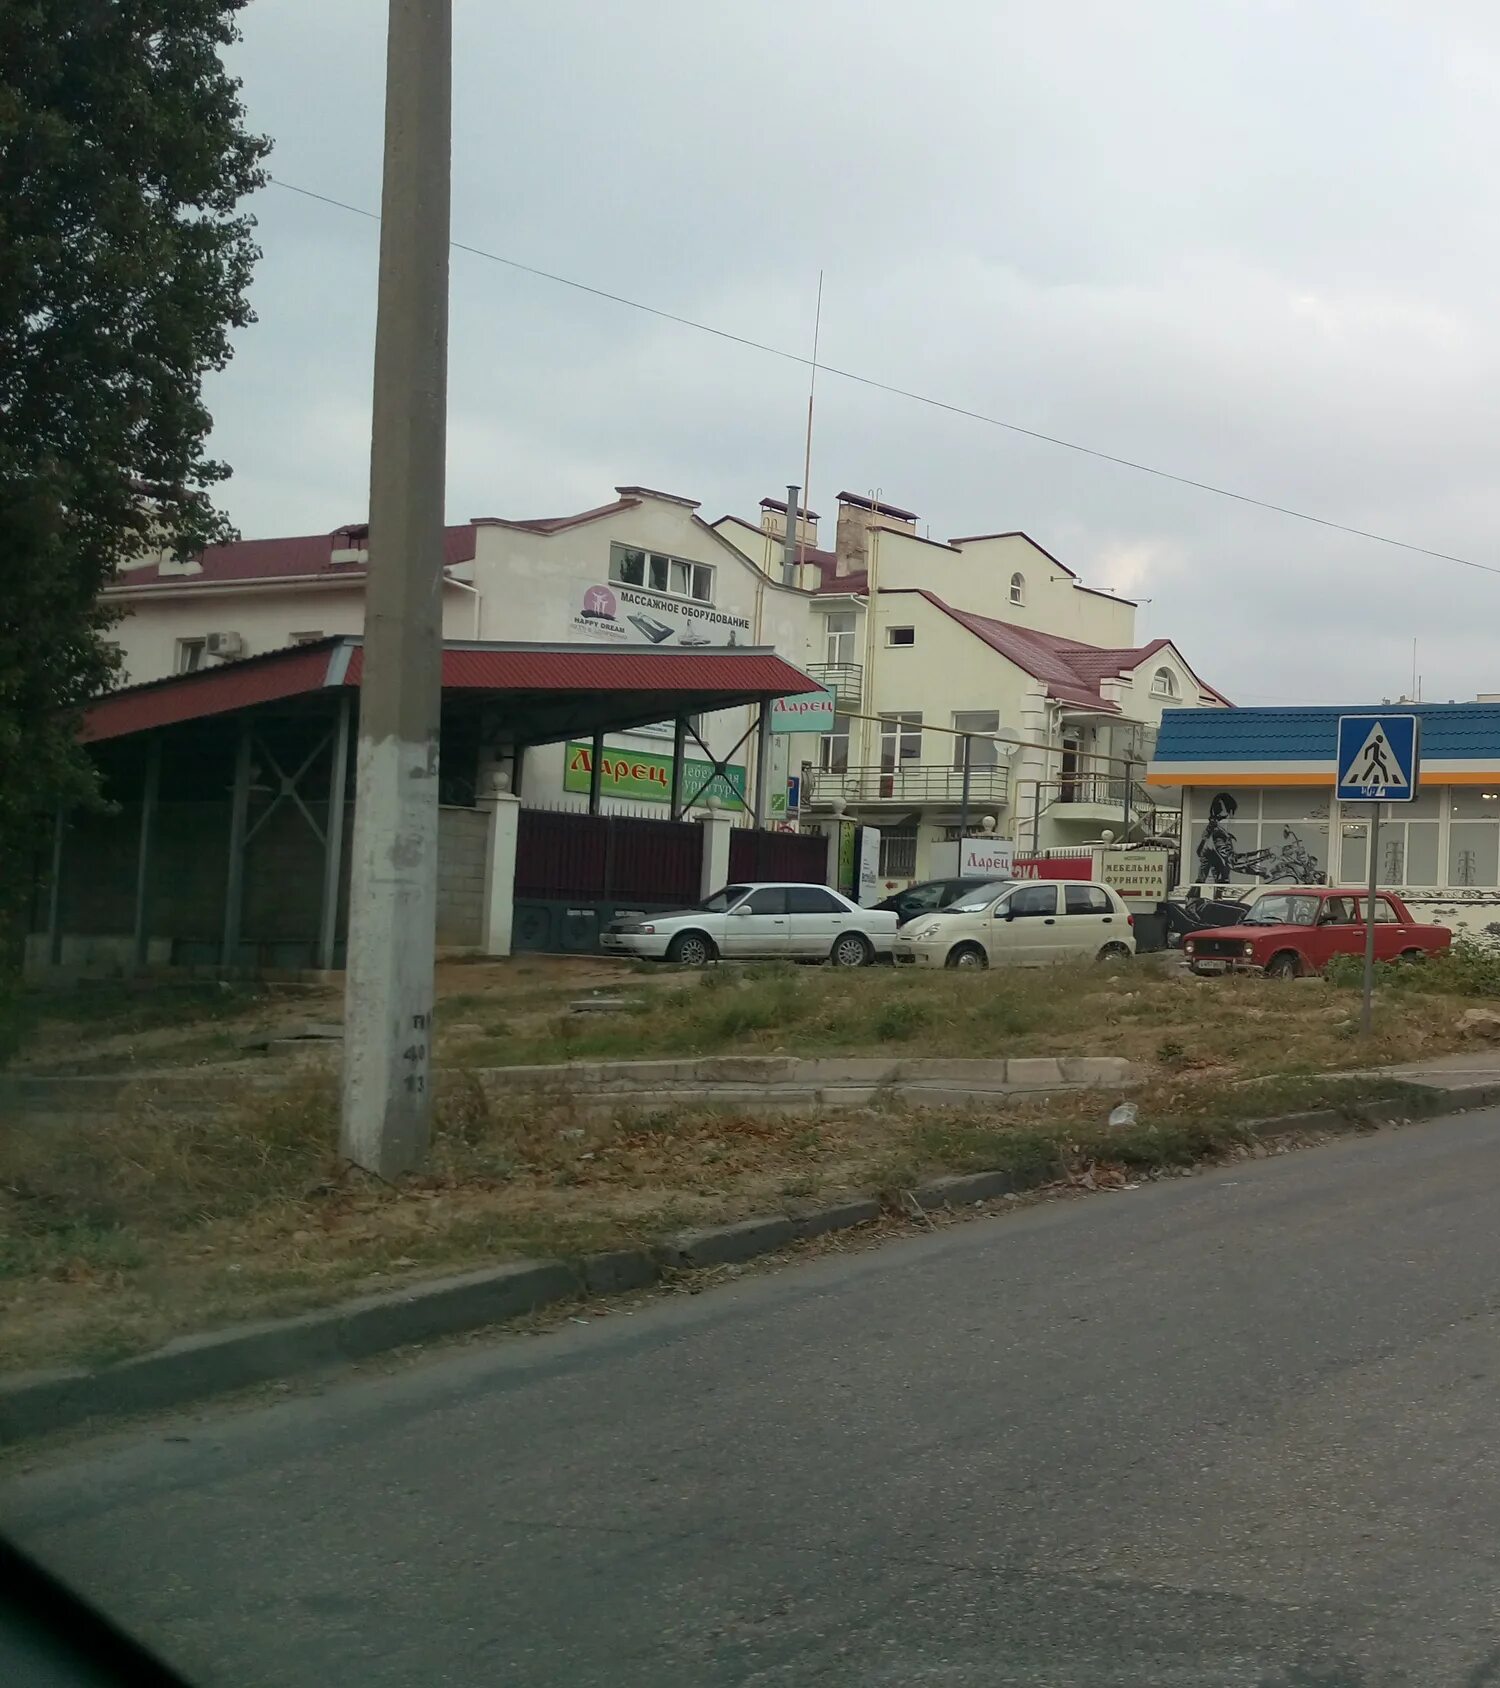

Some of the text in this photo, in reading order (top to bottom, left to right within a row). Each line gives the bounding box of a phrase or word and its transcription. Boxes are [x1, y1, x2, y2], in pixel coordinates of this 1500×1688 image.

[620, 591, 750, 629] МАССАЖНОЕ ОБОРУДОВАНИЕ
[574, 617, 599, 628] HAPPY
[600, 623, 625, 634] DREAM
[773, 698, 833, 715] Ларец
[570, 748, 669, 787] Ларец
[967, 852, 1009, 871] Ларец
[1106, 864, 1163, 872] МЕБЕЛЬНАЯ
[1105, 876, 1162, 885] ФУРНИТУРА
